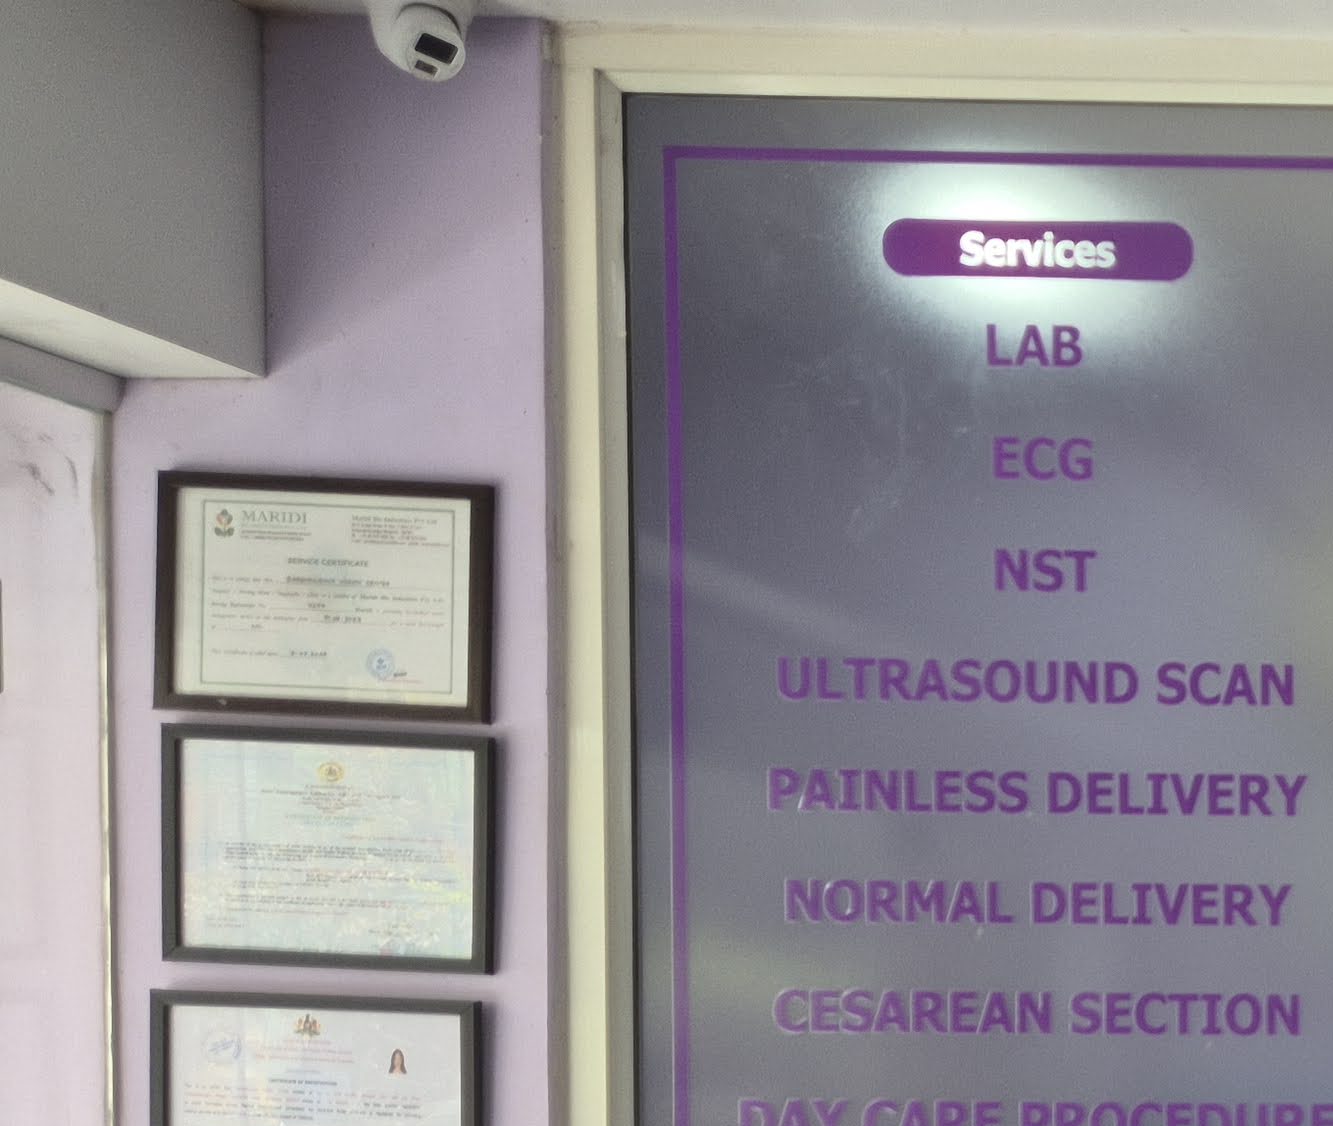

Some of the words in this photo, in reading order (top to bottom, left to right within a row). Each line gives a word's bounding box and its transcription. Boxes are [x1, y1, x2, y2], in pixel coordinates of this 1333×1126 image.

[959, 230, 1117, 269] Services
[985, 324, 1086, 370] LAB
[992, 436, 1096, 483] ECG
[241, 510, 307, 524] MARIDI
[994, 548, 1099, 594] NST
[777, 655, 1141, 706] ULTRASOUND
[1155, 661, 1295, 708] SCAN
[767, 767, 1031, 815] PAINLESS
[1047, 771, 1308, 818] DELIVERY
[785, 879, 1015, 926] NORMAL
[1031, 882, 1292, 928] DELIVERY
[774, 989, 1054, 1036] CESAREAN
[1071, 991, 1303, 1038] SECTION
